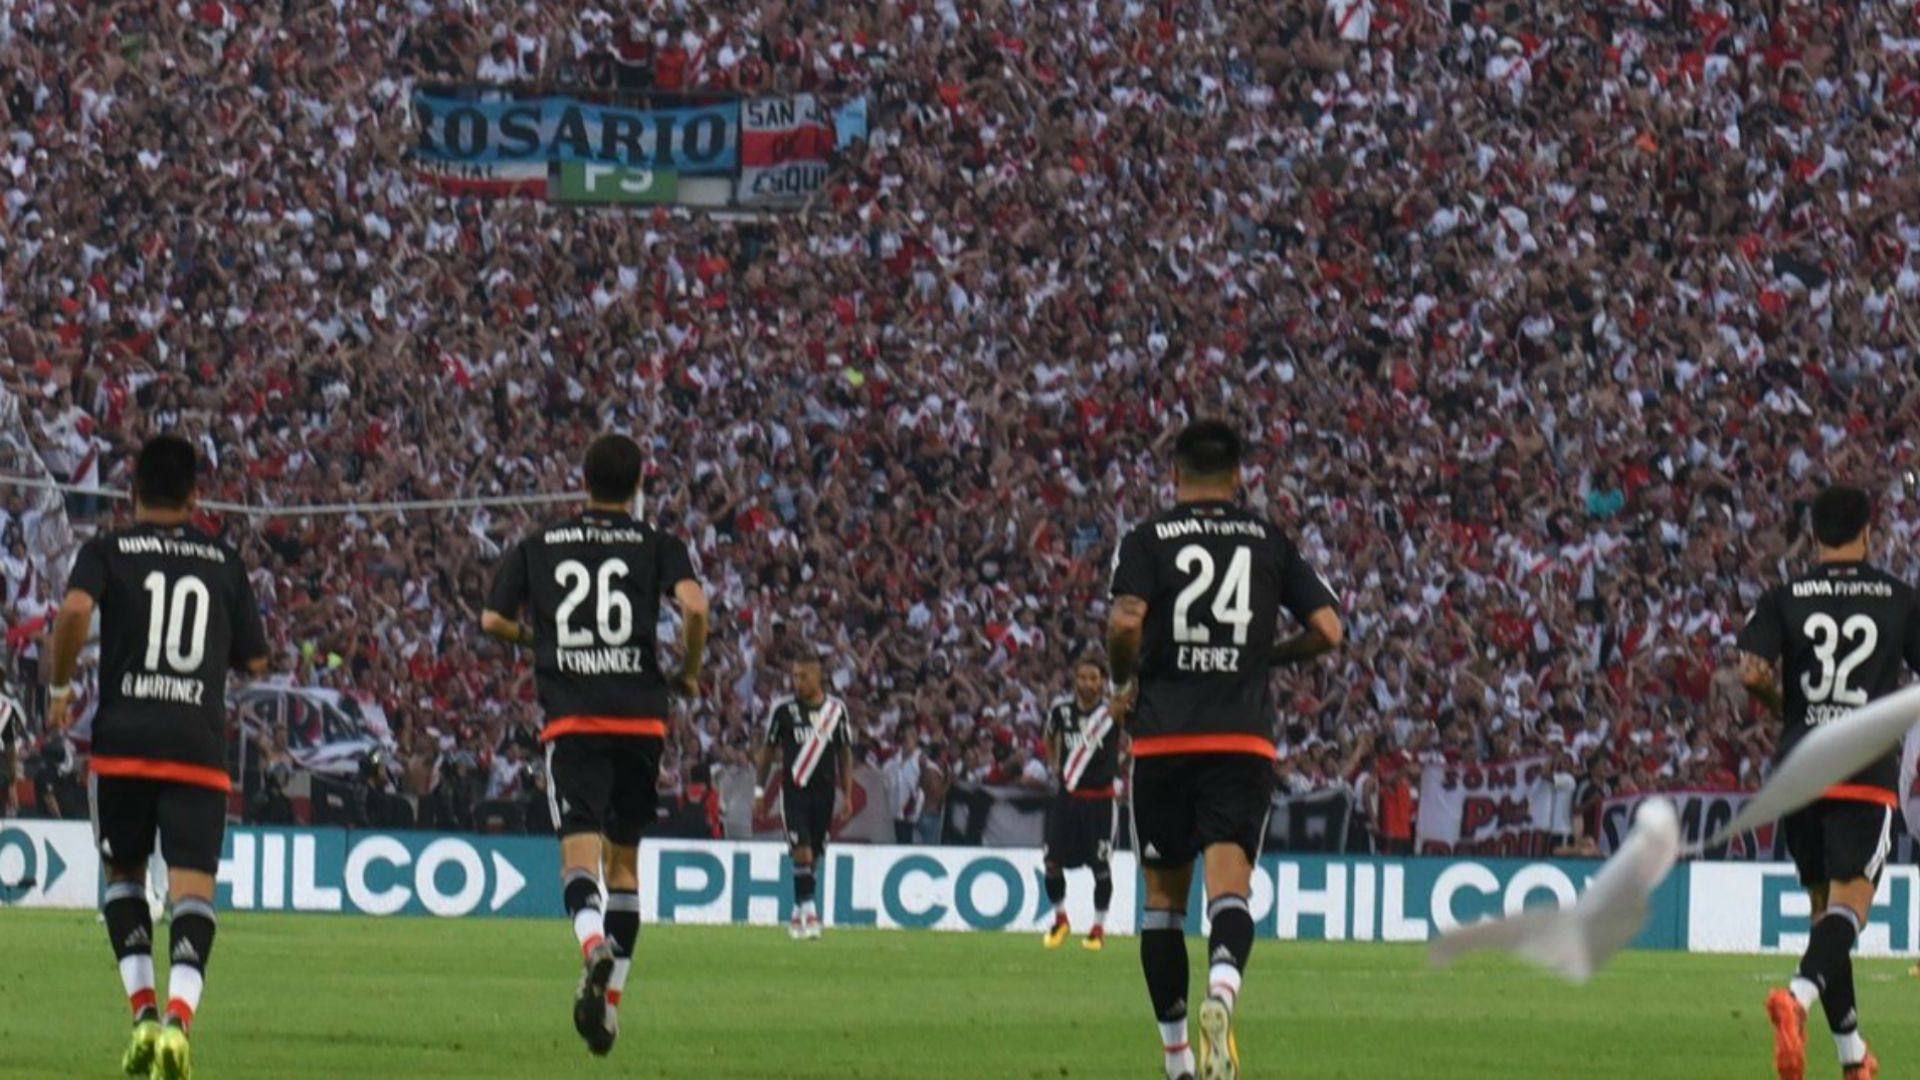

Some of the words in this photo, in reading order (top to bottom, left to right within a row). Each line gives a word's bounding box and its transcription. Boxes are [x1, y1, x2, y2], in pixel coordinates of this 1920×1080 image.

[414, 102, 726, 166] ROSARIO
[748, 101, 795, 127] SAN
[118, 537, 162, 554] BBVA
[545, 527, 584, 544] BBVA
[1155, 518, 1202, 540] BBVA
[554, 557, 633, 646] 26
[1173, 544, 1253, 646] 24
[1793, 580, 1832, 597] BBVA
[144, 570, 210, 674] 10
[557, 647, 642, 675] FERNANDEZ
[1801, 612, 1878, 704] 32
[215, 832, 486, 917] HILCO
